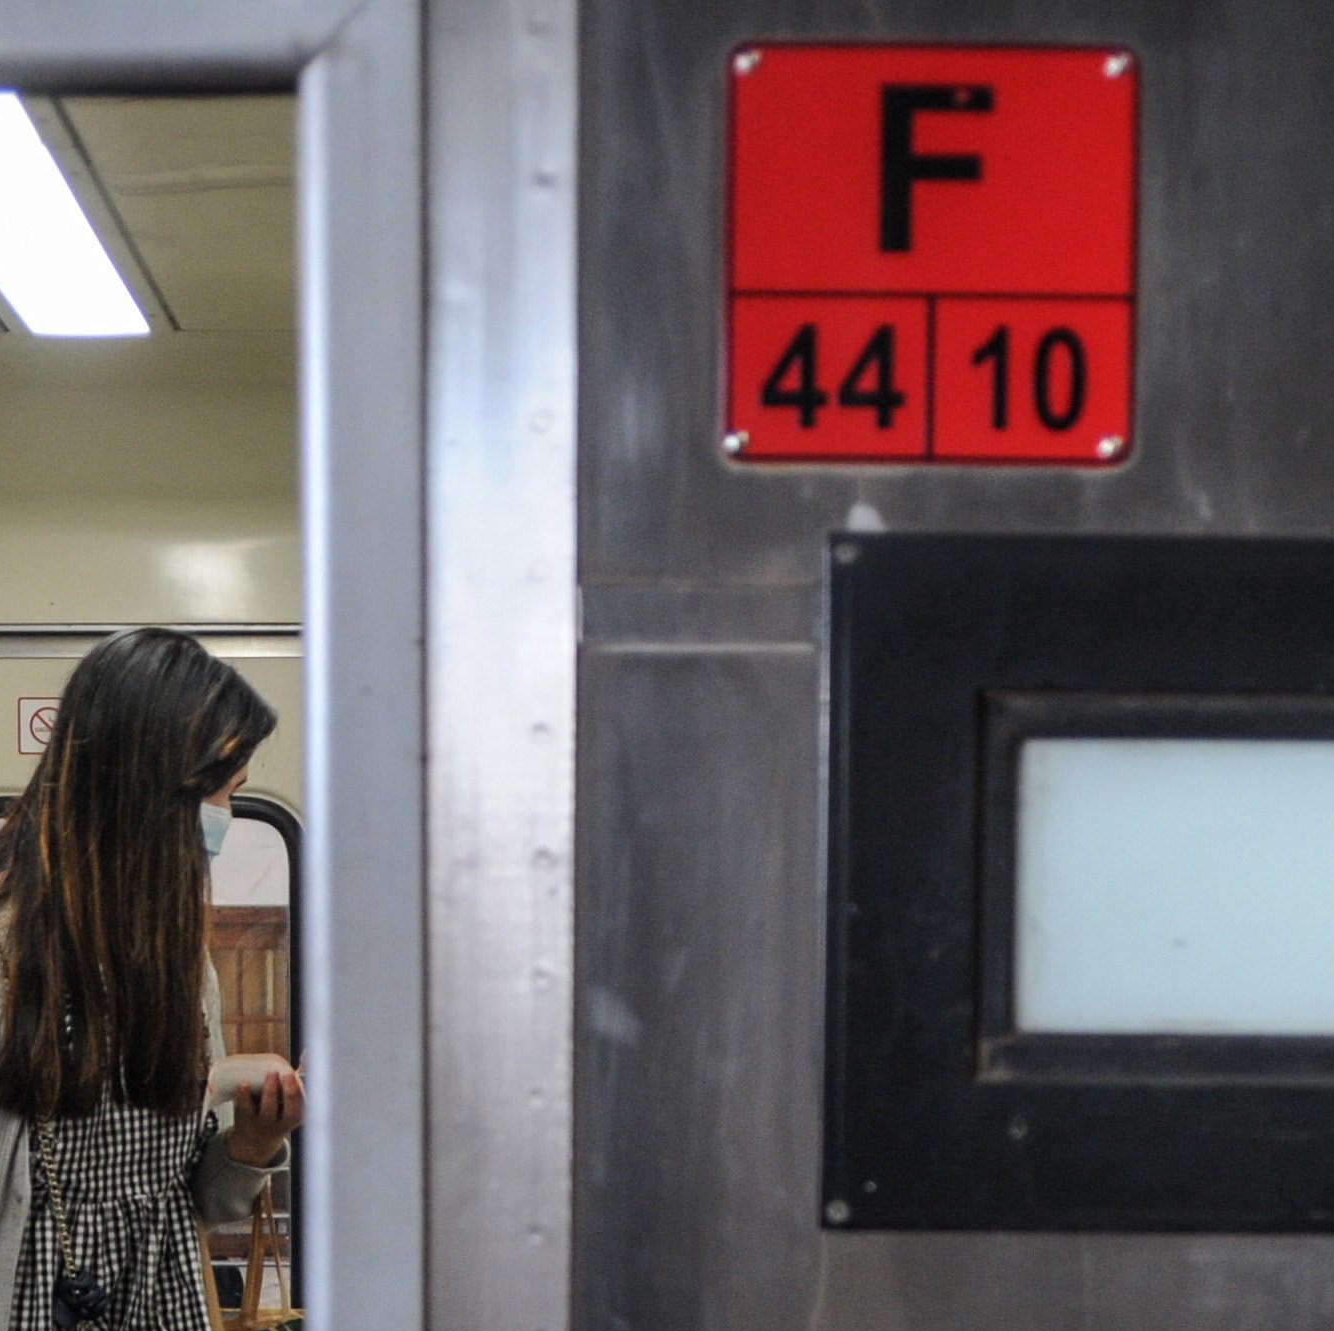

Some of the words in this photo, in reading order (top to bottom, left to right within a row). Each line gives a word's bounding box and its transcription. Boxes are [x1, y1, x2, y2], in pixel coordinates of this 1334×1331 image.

[878, 82, 996, 254] F
[759, 323, 906, 431] 44
[971, 325, 1089, 433] 10
